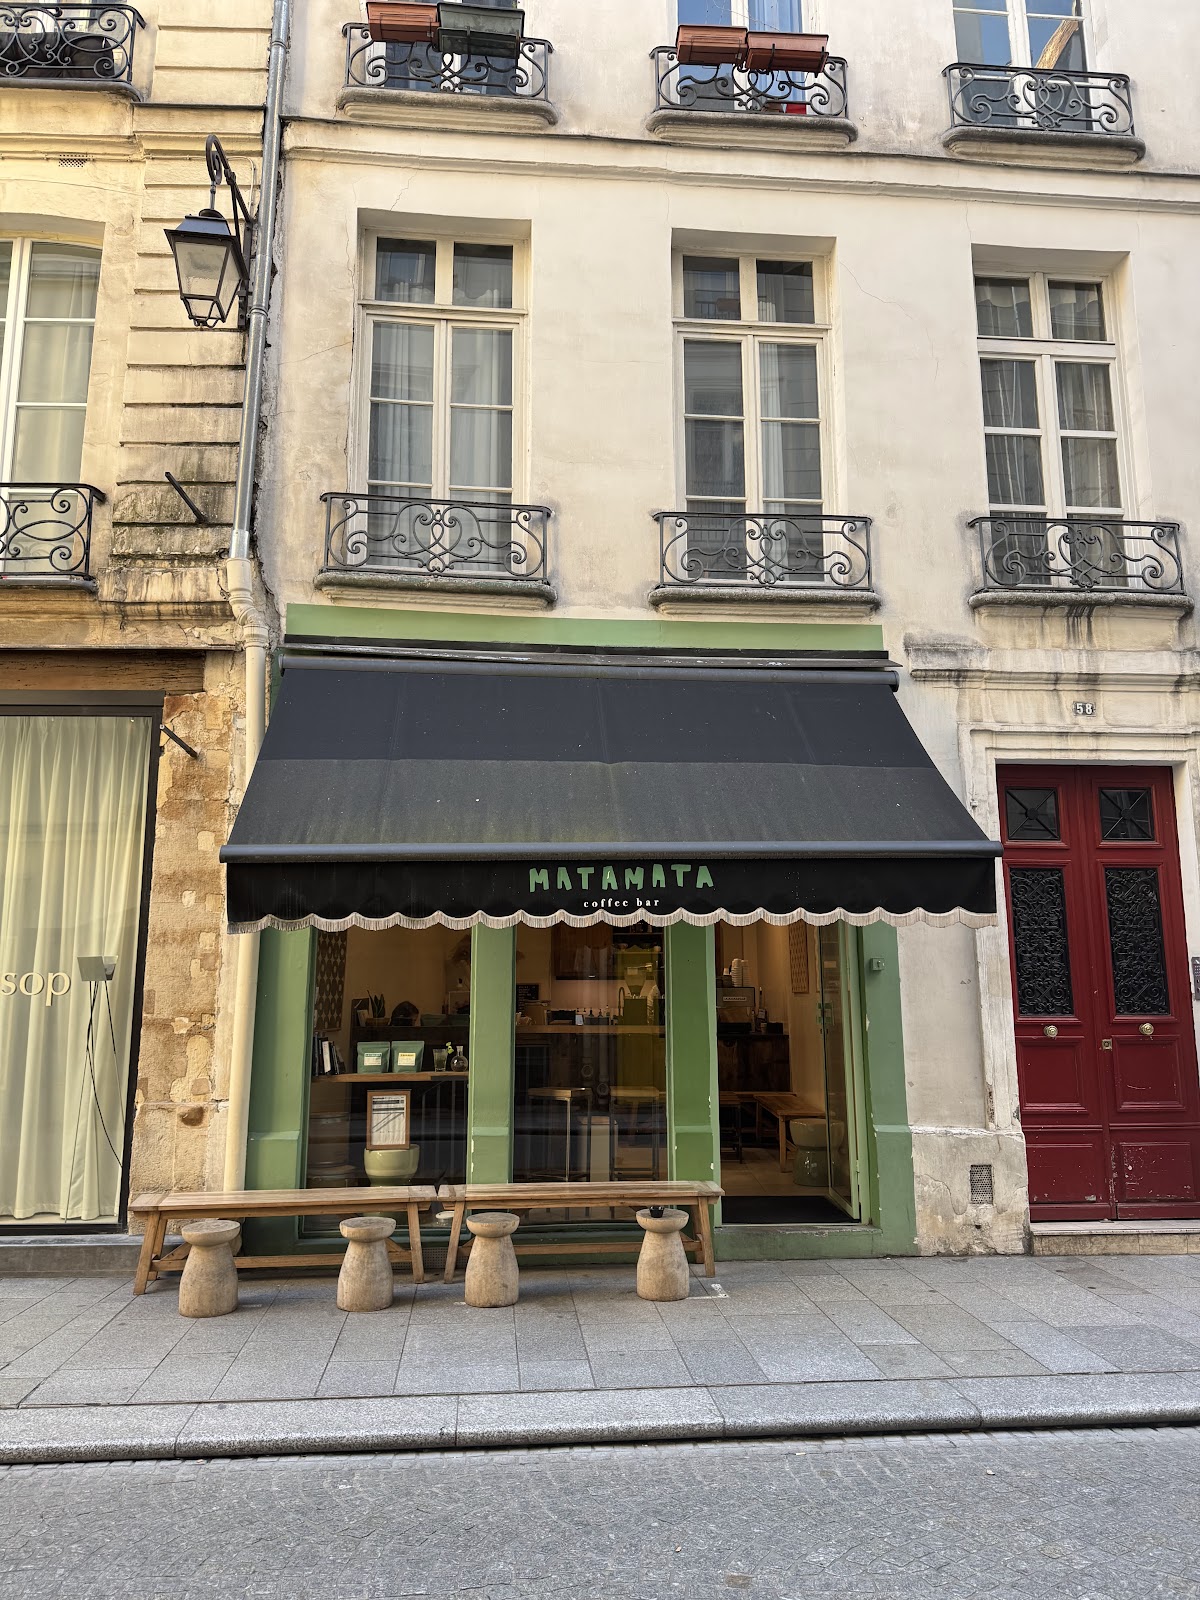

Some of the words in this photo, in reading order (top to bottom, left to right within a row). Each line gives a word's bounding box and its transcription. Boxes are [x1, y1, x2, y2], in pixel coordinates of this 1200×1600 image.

[1076, 702, 1093, 715] 58
[529, 864, 714, 892] MATAMATA
[583, 898, 629, 908] coffee
[636, 897, 660, 907] bar
